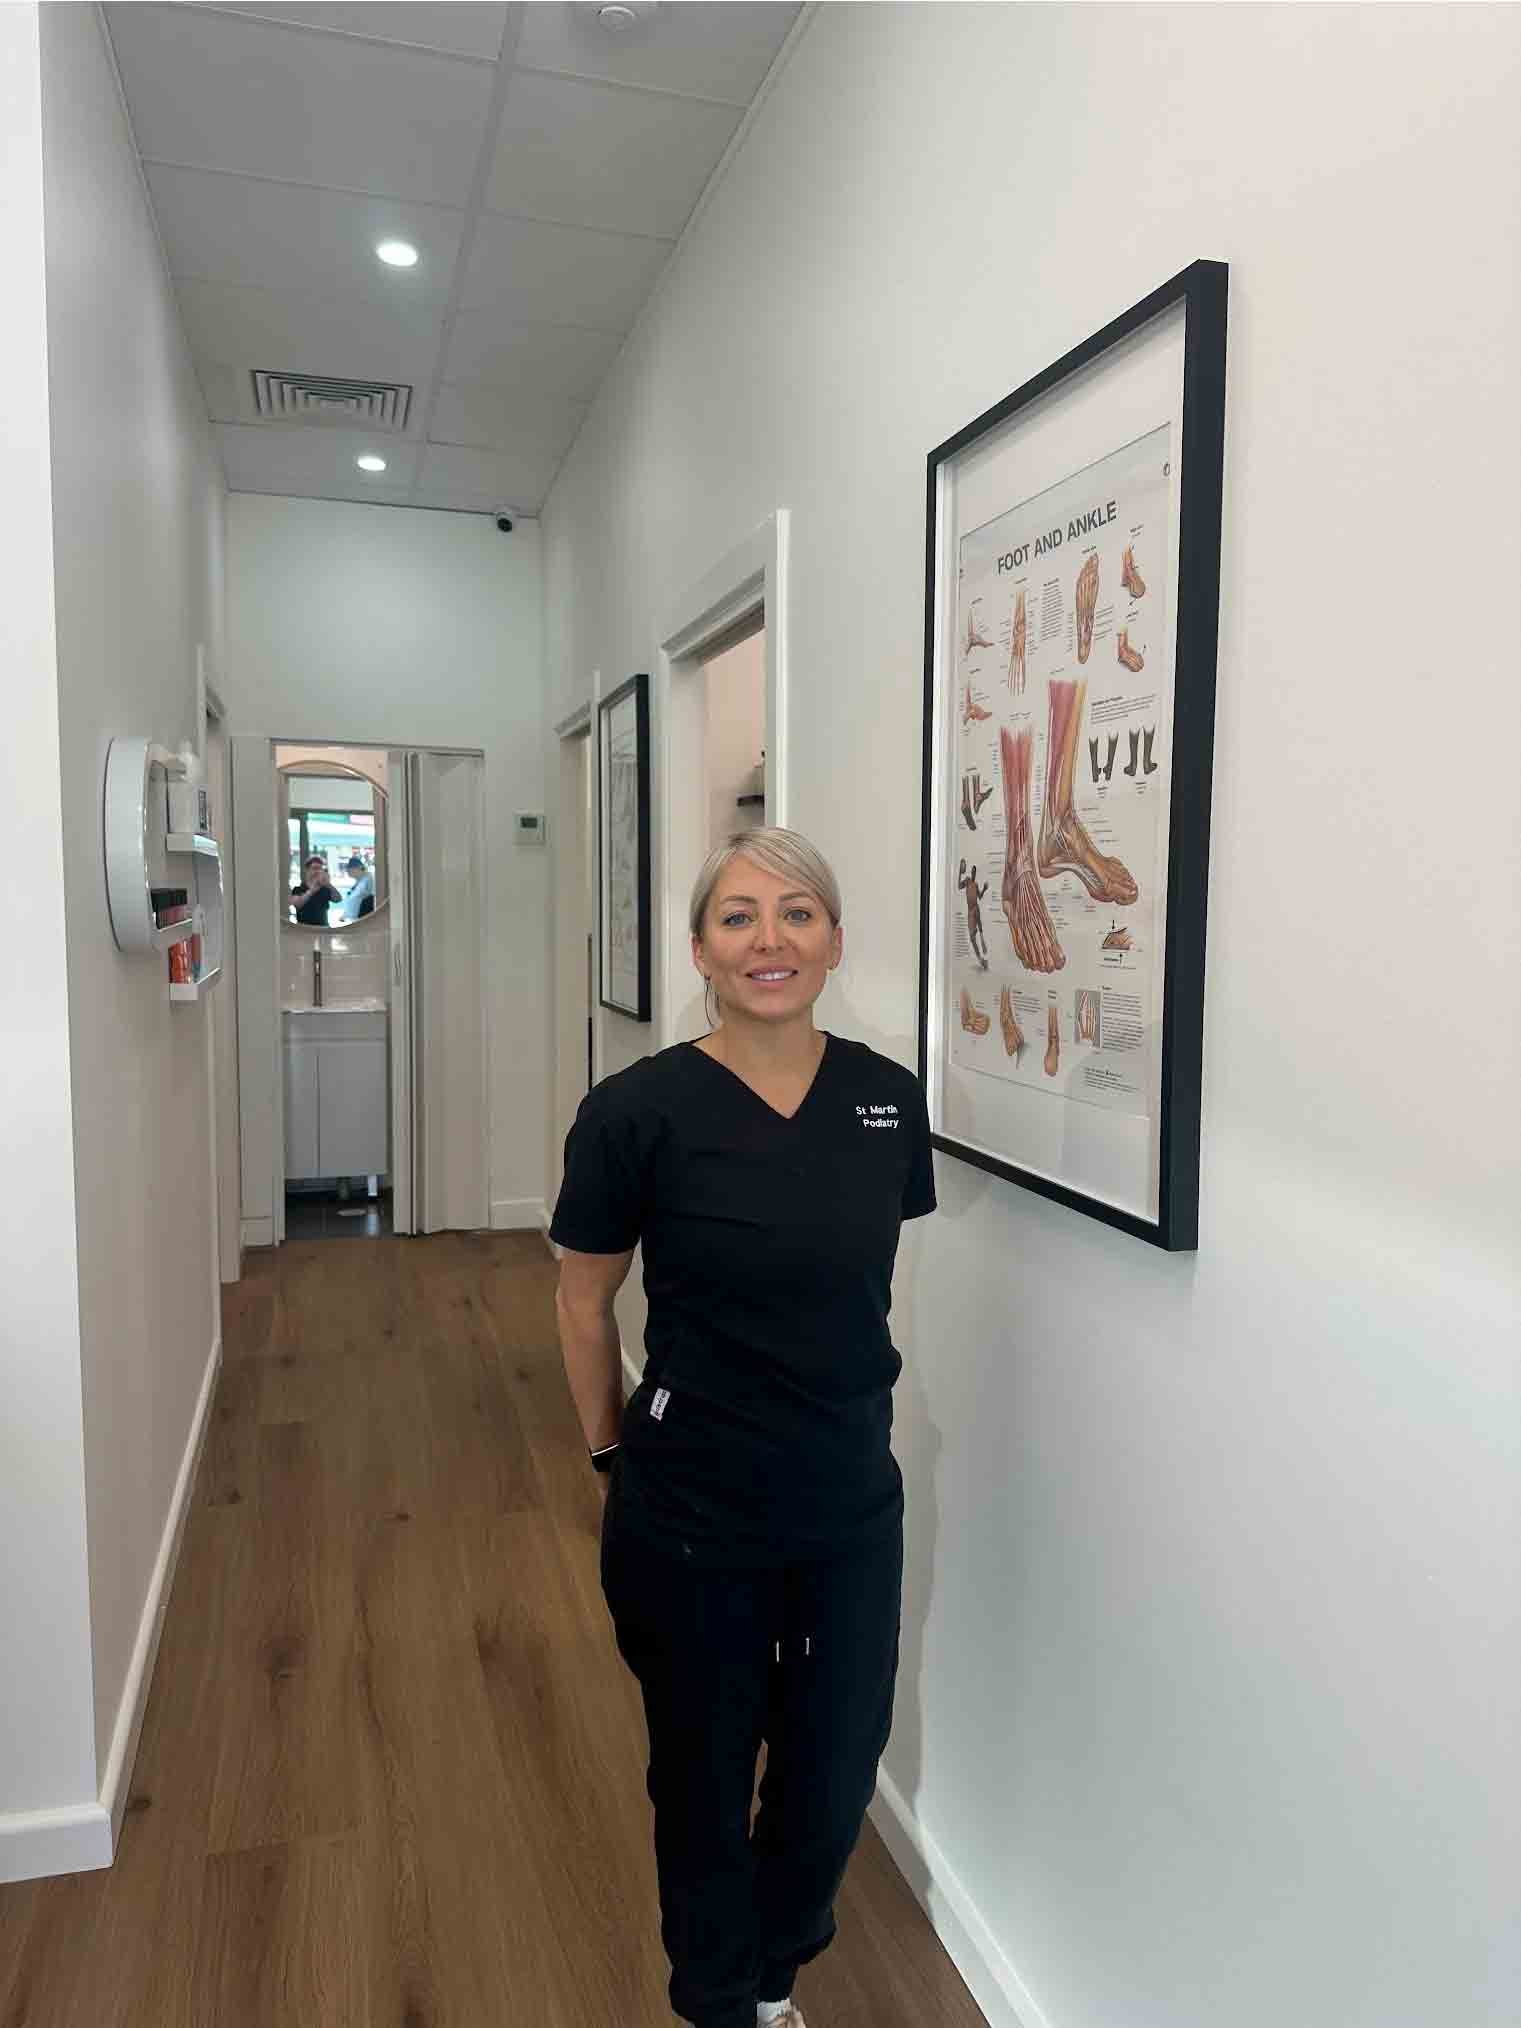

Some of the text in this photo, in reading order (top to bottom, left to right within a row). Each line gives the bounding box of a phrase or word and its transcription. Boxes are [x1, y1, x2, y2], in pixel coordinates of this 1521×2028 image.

[997, 544, 1030, 575] FOOT
[1034, 528, 1063, 558] AND
[1067, 501, 1117, 542] ANKLE
[855, 1105, 898, 1115] St Martin
[863, 1118, 899, 1129] Podiatry
